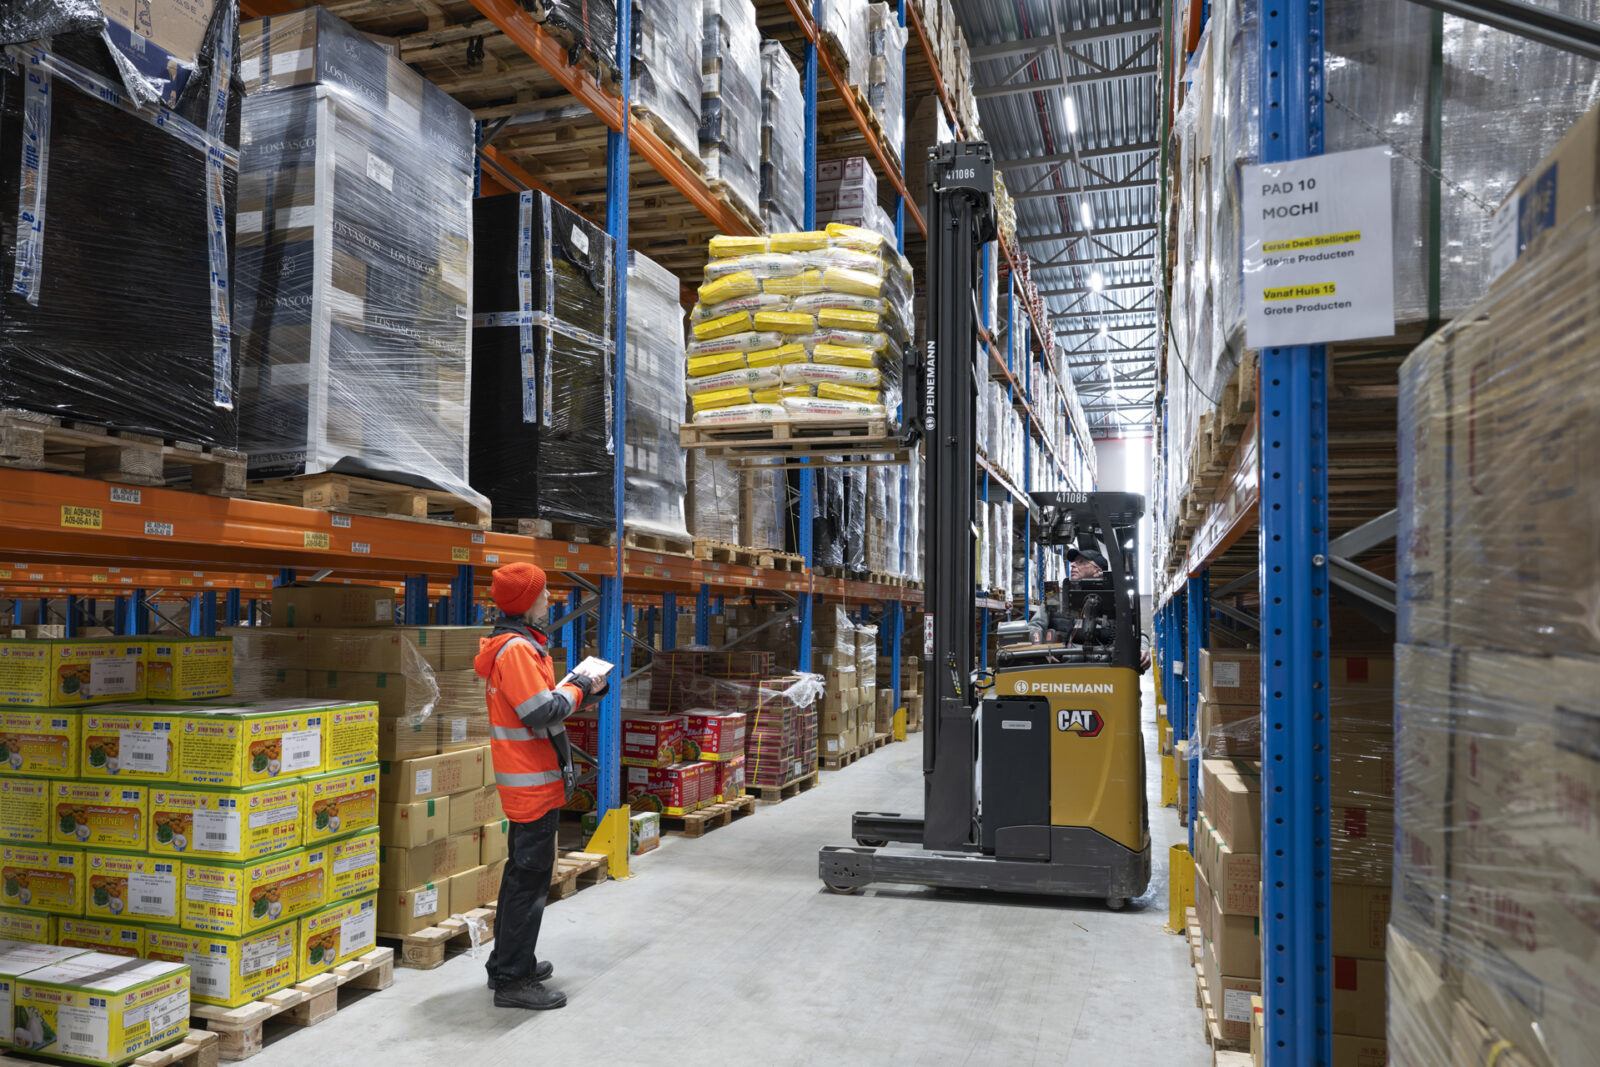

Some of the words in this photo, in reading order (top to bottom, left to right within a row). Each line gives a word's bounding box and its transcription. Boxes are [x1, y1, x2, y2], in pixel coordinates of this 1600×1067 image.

[946, 168, 975, 180] 411086
[1262, 182, 1293, 196] PAD
[1298, 178, 1316, 192] 10
[1262, 201, 1318, 220] MOCHI
[1292, 239, 1313, 249] Deel
[1314, 233, 1360, 246] Stellingen
[1298, 250, 1354, 262] Producten
[1264, 288, 1294, 299] Vanaf
[1296, 286, 1320, 296] Huis
[1323, 284, 1336, 294] 15
[1264, 306, 1294, 316] Grote
[1296, 301, 1352, 312] Producten
[926, 340, 936, 414] PEINEMANN
[1056, 492, 1088, 503] 411086
[1032, 682, 1114, 694] PEINEMANN
[1057, 710, 1093, 731] CAT
